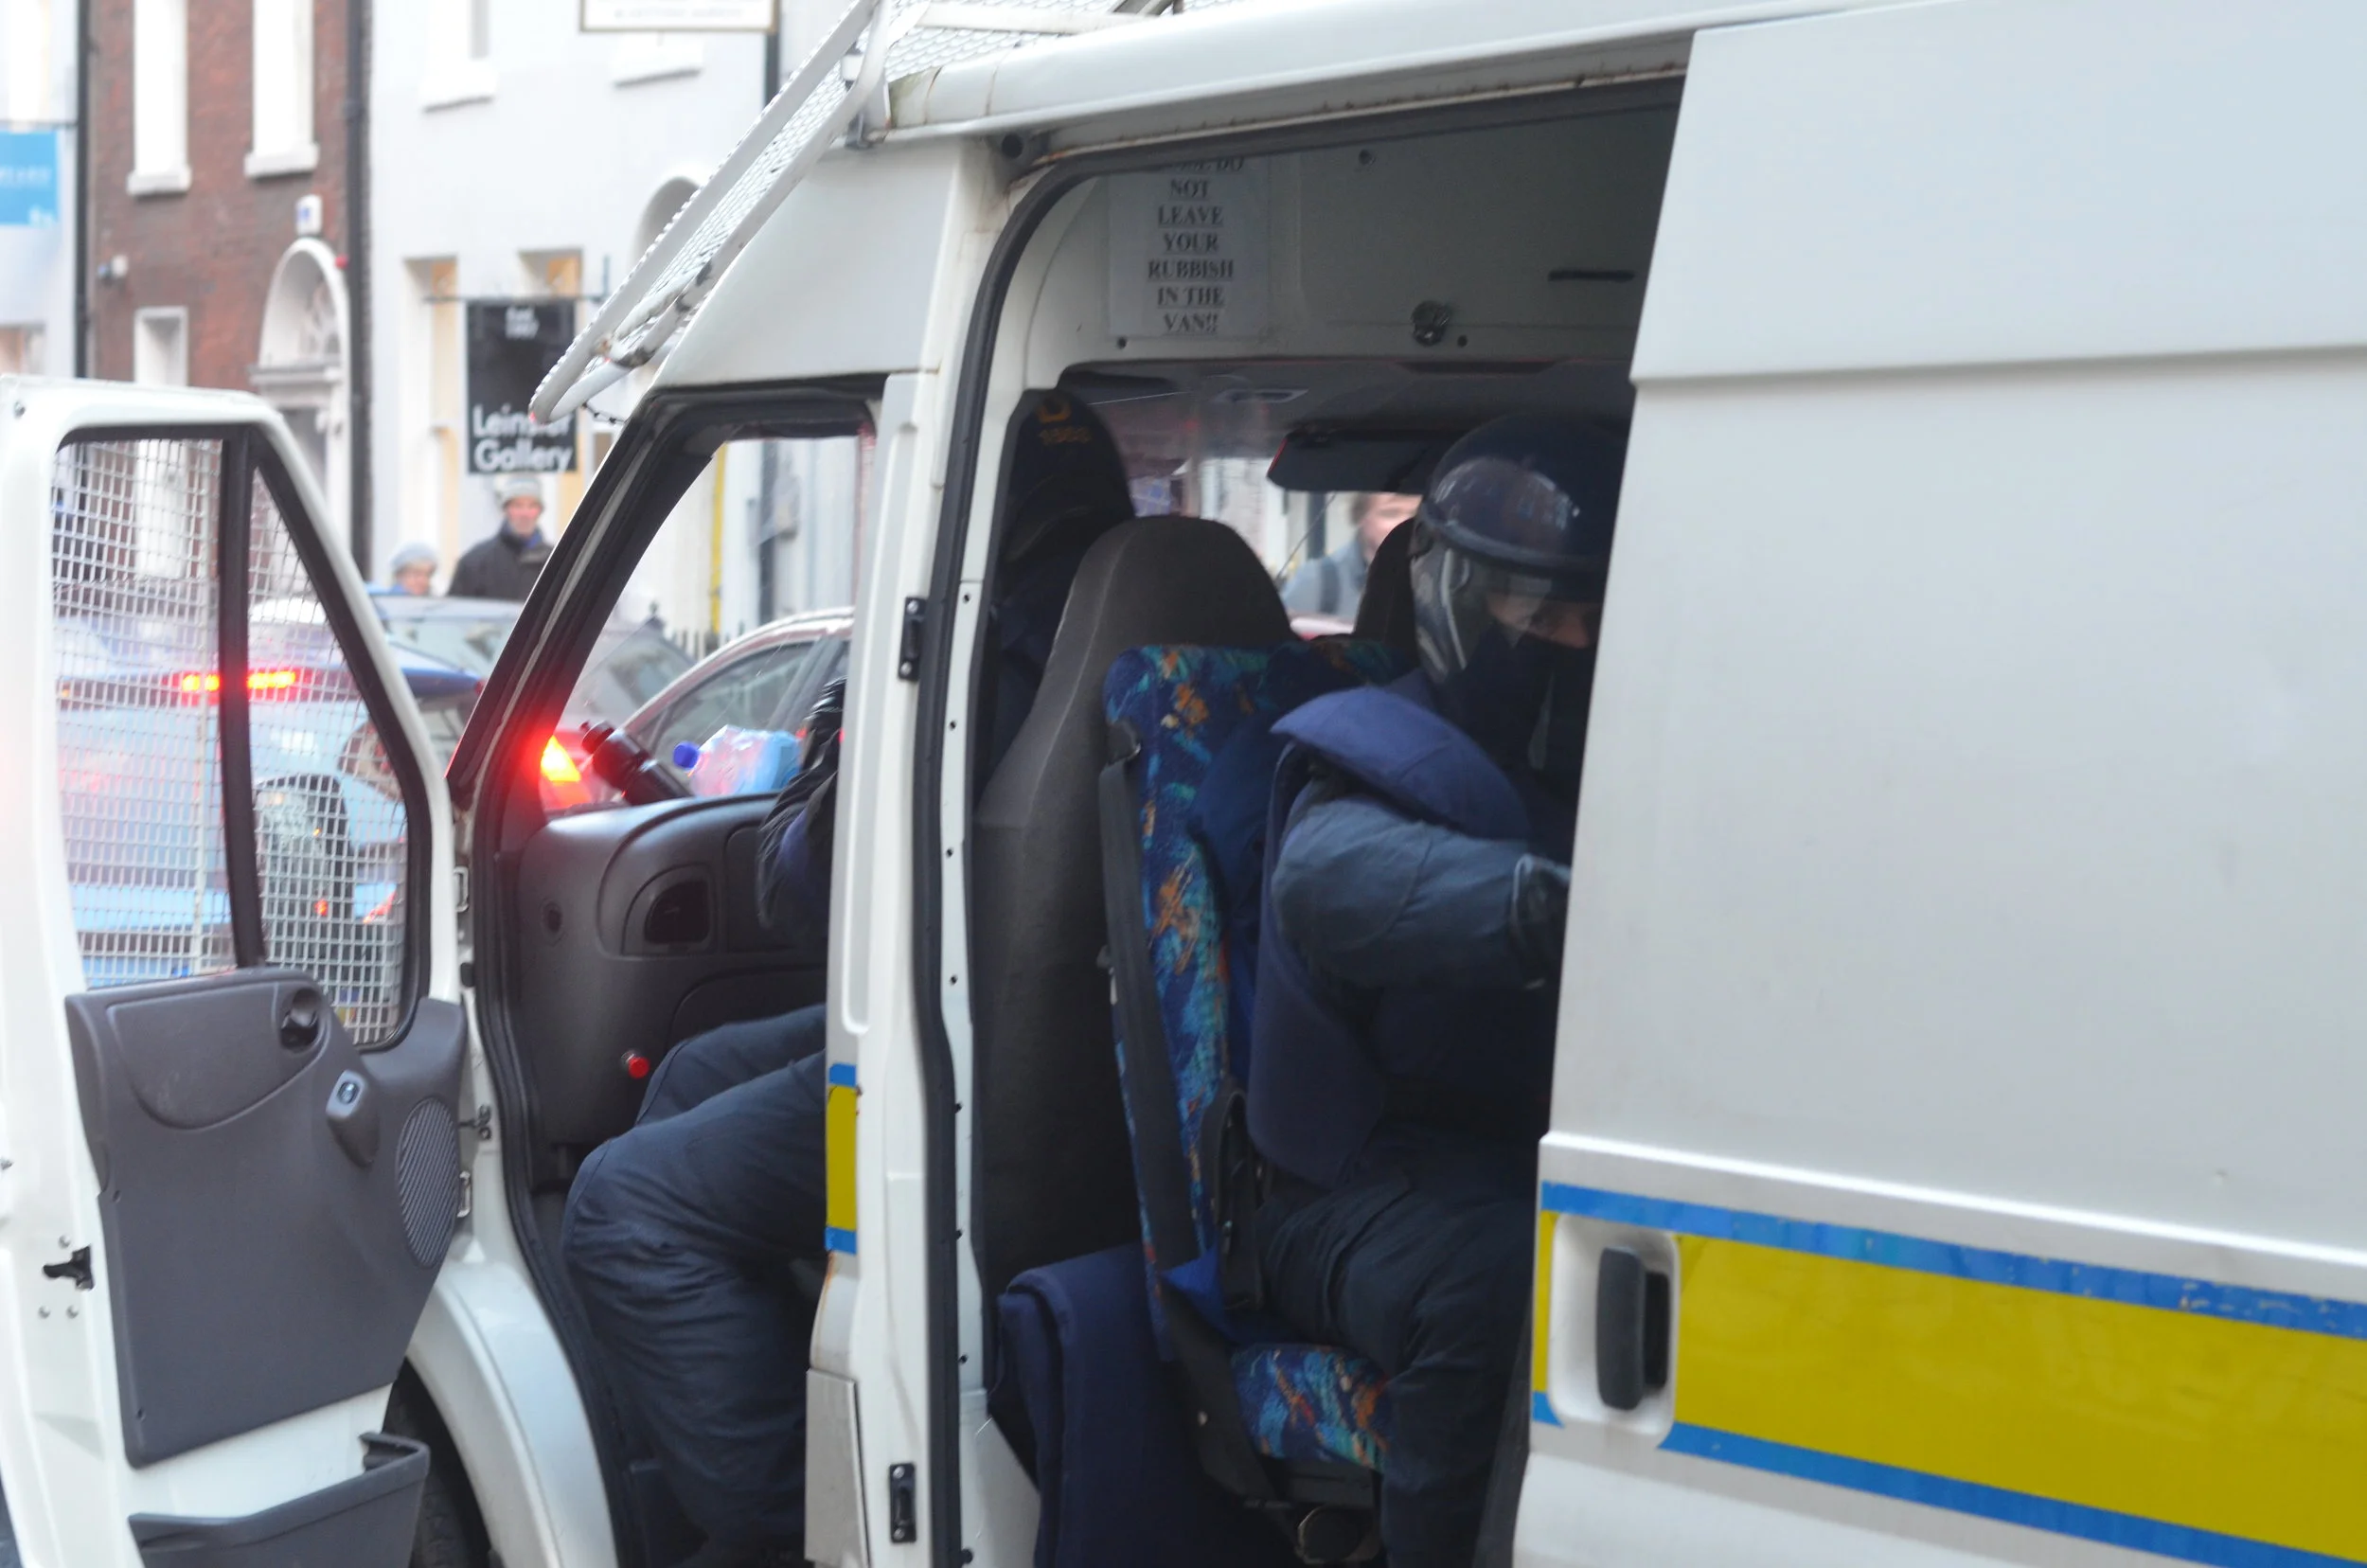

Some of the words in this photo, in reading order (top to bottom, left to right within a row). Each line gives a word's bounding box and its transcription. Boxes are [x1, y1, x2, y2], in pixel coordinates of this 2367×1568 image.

[1169, 179, 1209, 199] NOT
[1157, 205, 1224, 226] LEAVE
[1163, 233, 1219, 254] YOUR
[1148, 258, 1234, 279] RUBBISH
[1157, 286, 1179, 307] IN
[1184, 286, 1224, 307] THE
[1164, 312, 1219, 333] VAN!!
[474, 437, 574, 474] Gallery
